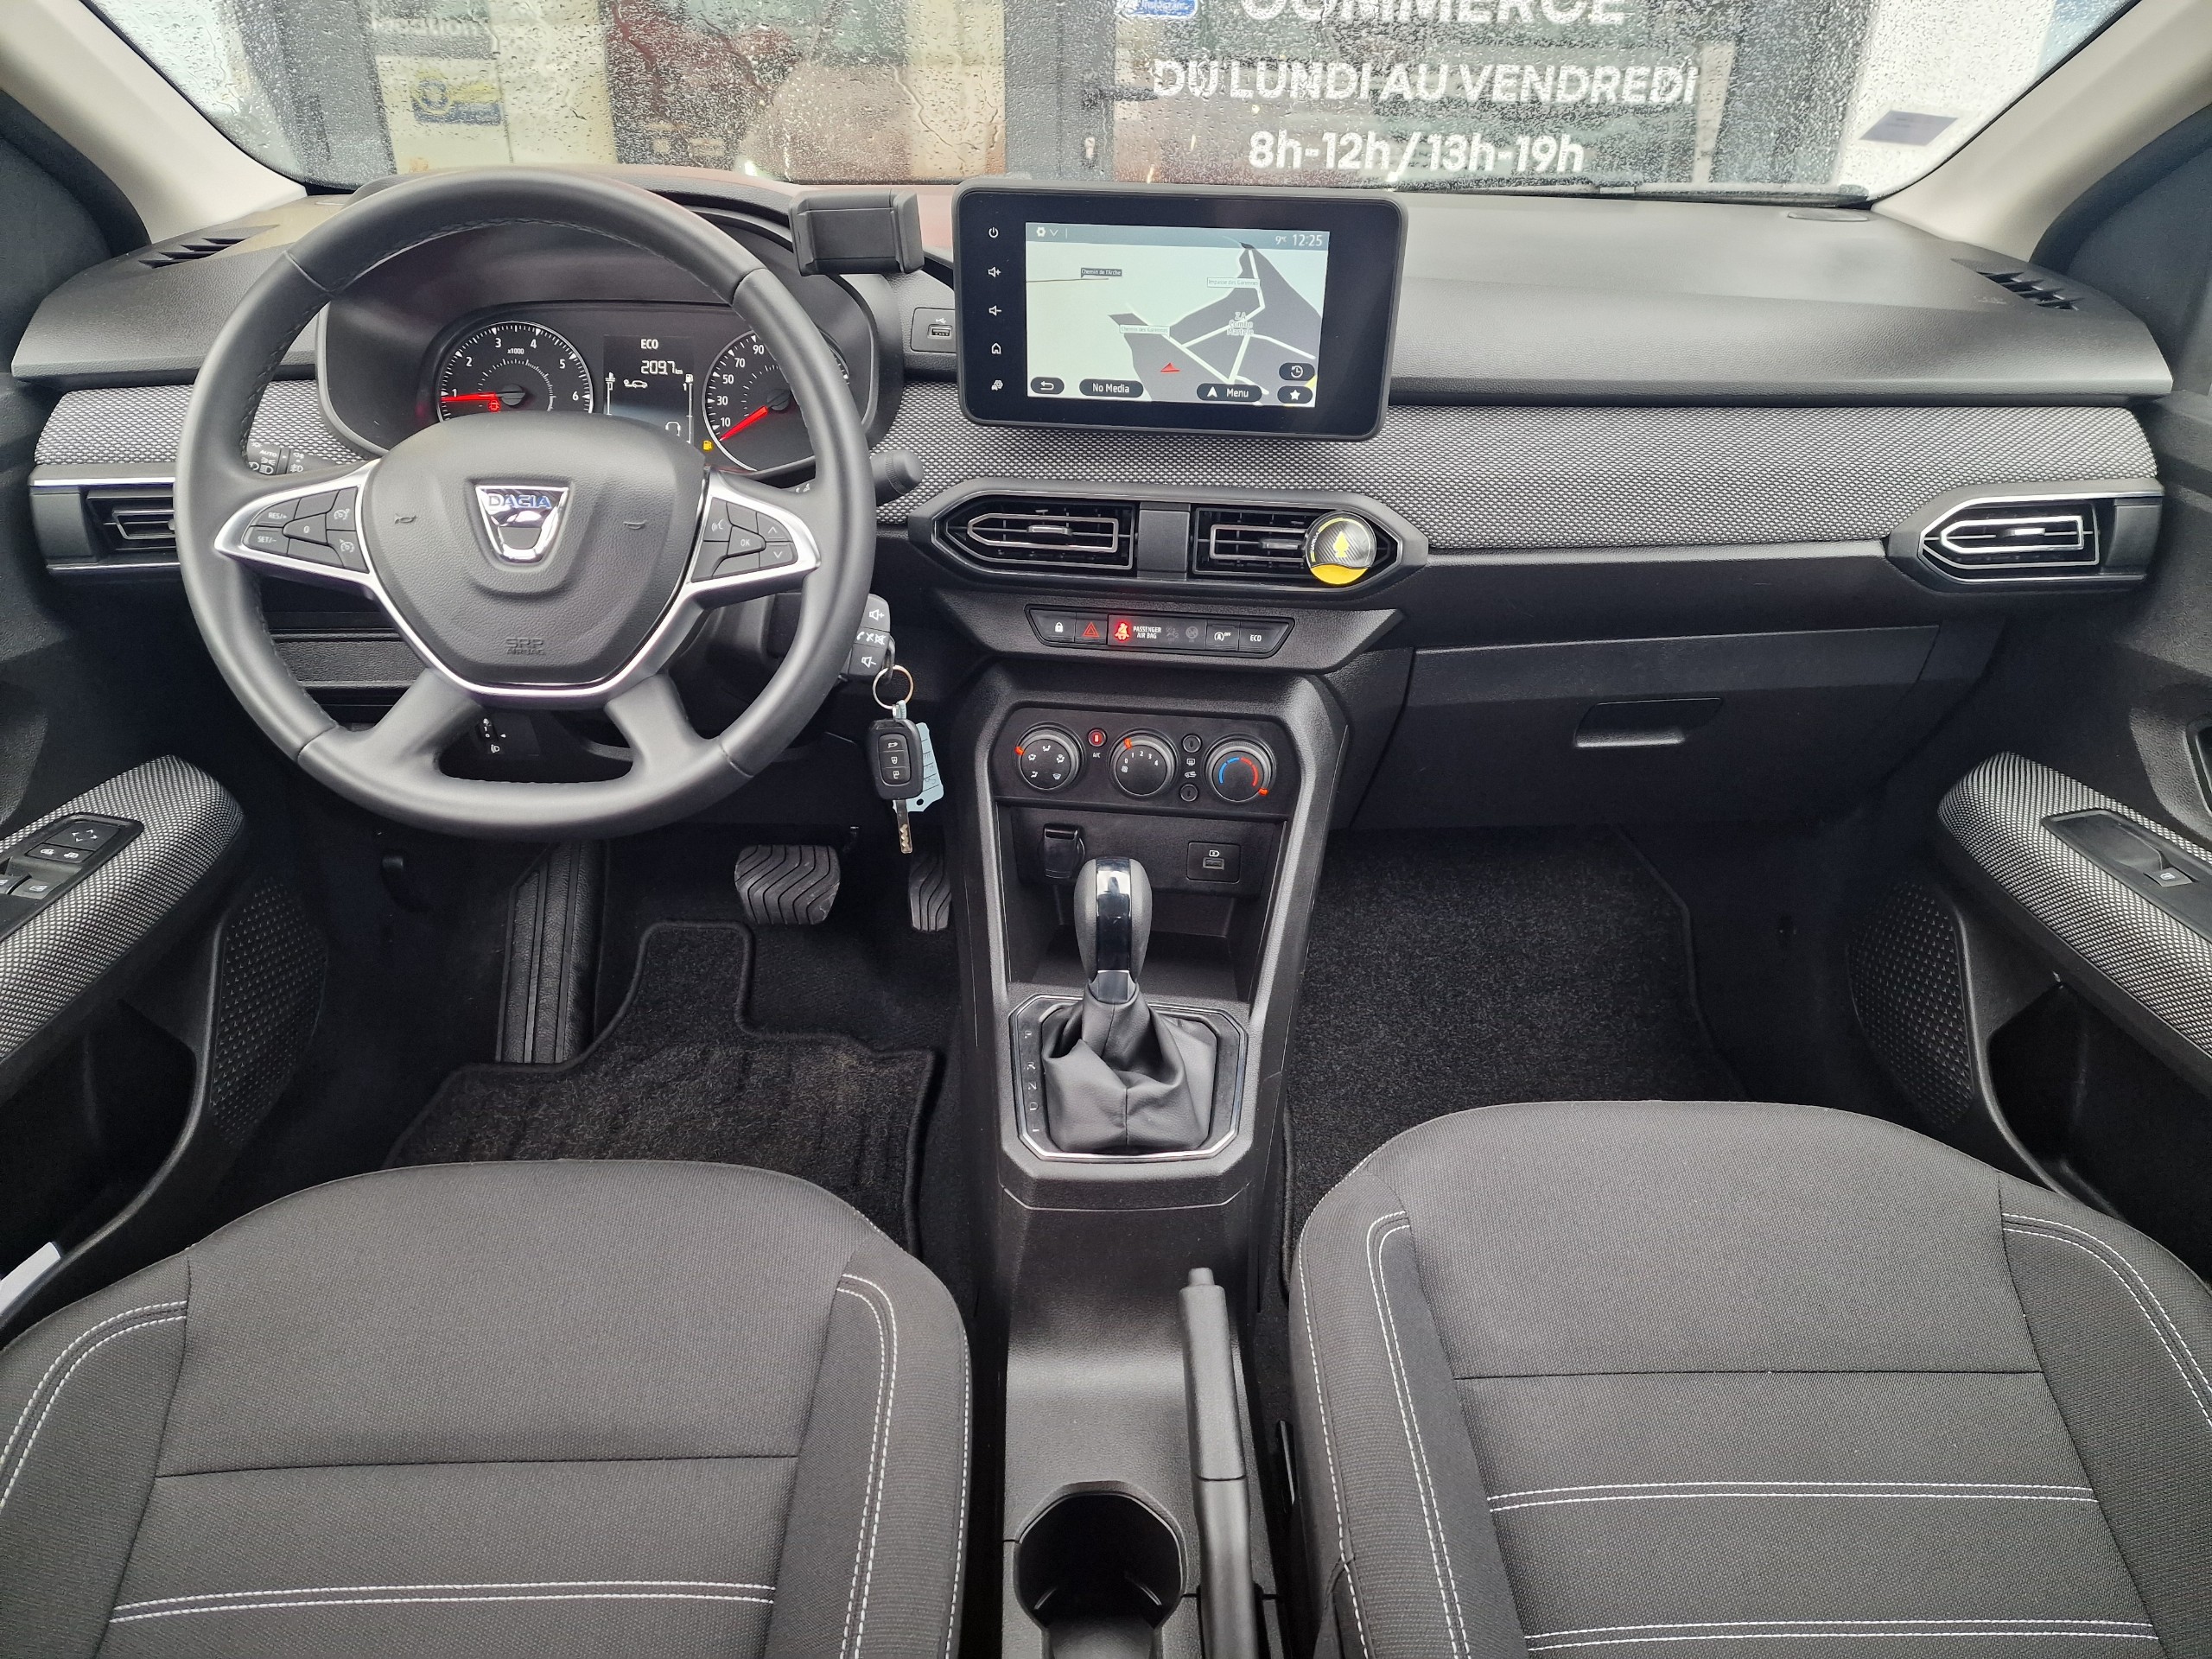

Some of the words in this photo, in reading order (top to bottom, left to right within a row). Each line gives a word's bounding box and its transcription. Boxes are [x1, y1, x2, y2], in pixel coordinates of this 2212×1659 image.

[1154, 60, 1219, 99] DU
[1230, 60, 1372, 100] LUNDI
[1382, 63, 1448, 102] AU
[1459, 63, 1698, 105] VENDREDI
[1292, 234, 1323, 246] 12:25
[495, 338, 502, 348] 3
[530, 339, 537, 349] 4
[640, 339, 658, 349] ECO
[753, 344, 765, 355] 90
[466, 357, 473, 367] 2
[559, 359, 566, 369] 5
[734, 358, 746, 368] 70
[722, 374, 734, 385] 50
[1092, 383, 1103, 392] No
[1105, 384, 1130, 393] Media
[1226, 388, 1249, 397] Menu
[572, 391, 579, 401] 6
[716, 395, 728, 405] 30
[720, 417, 731, 427] 10
[489, 493, 553, 509] DACIA
[740, 538, 751, 547] OK
[1029, 1102, 1039, 1111] D
